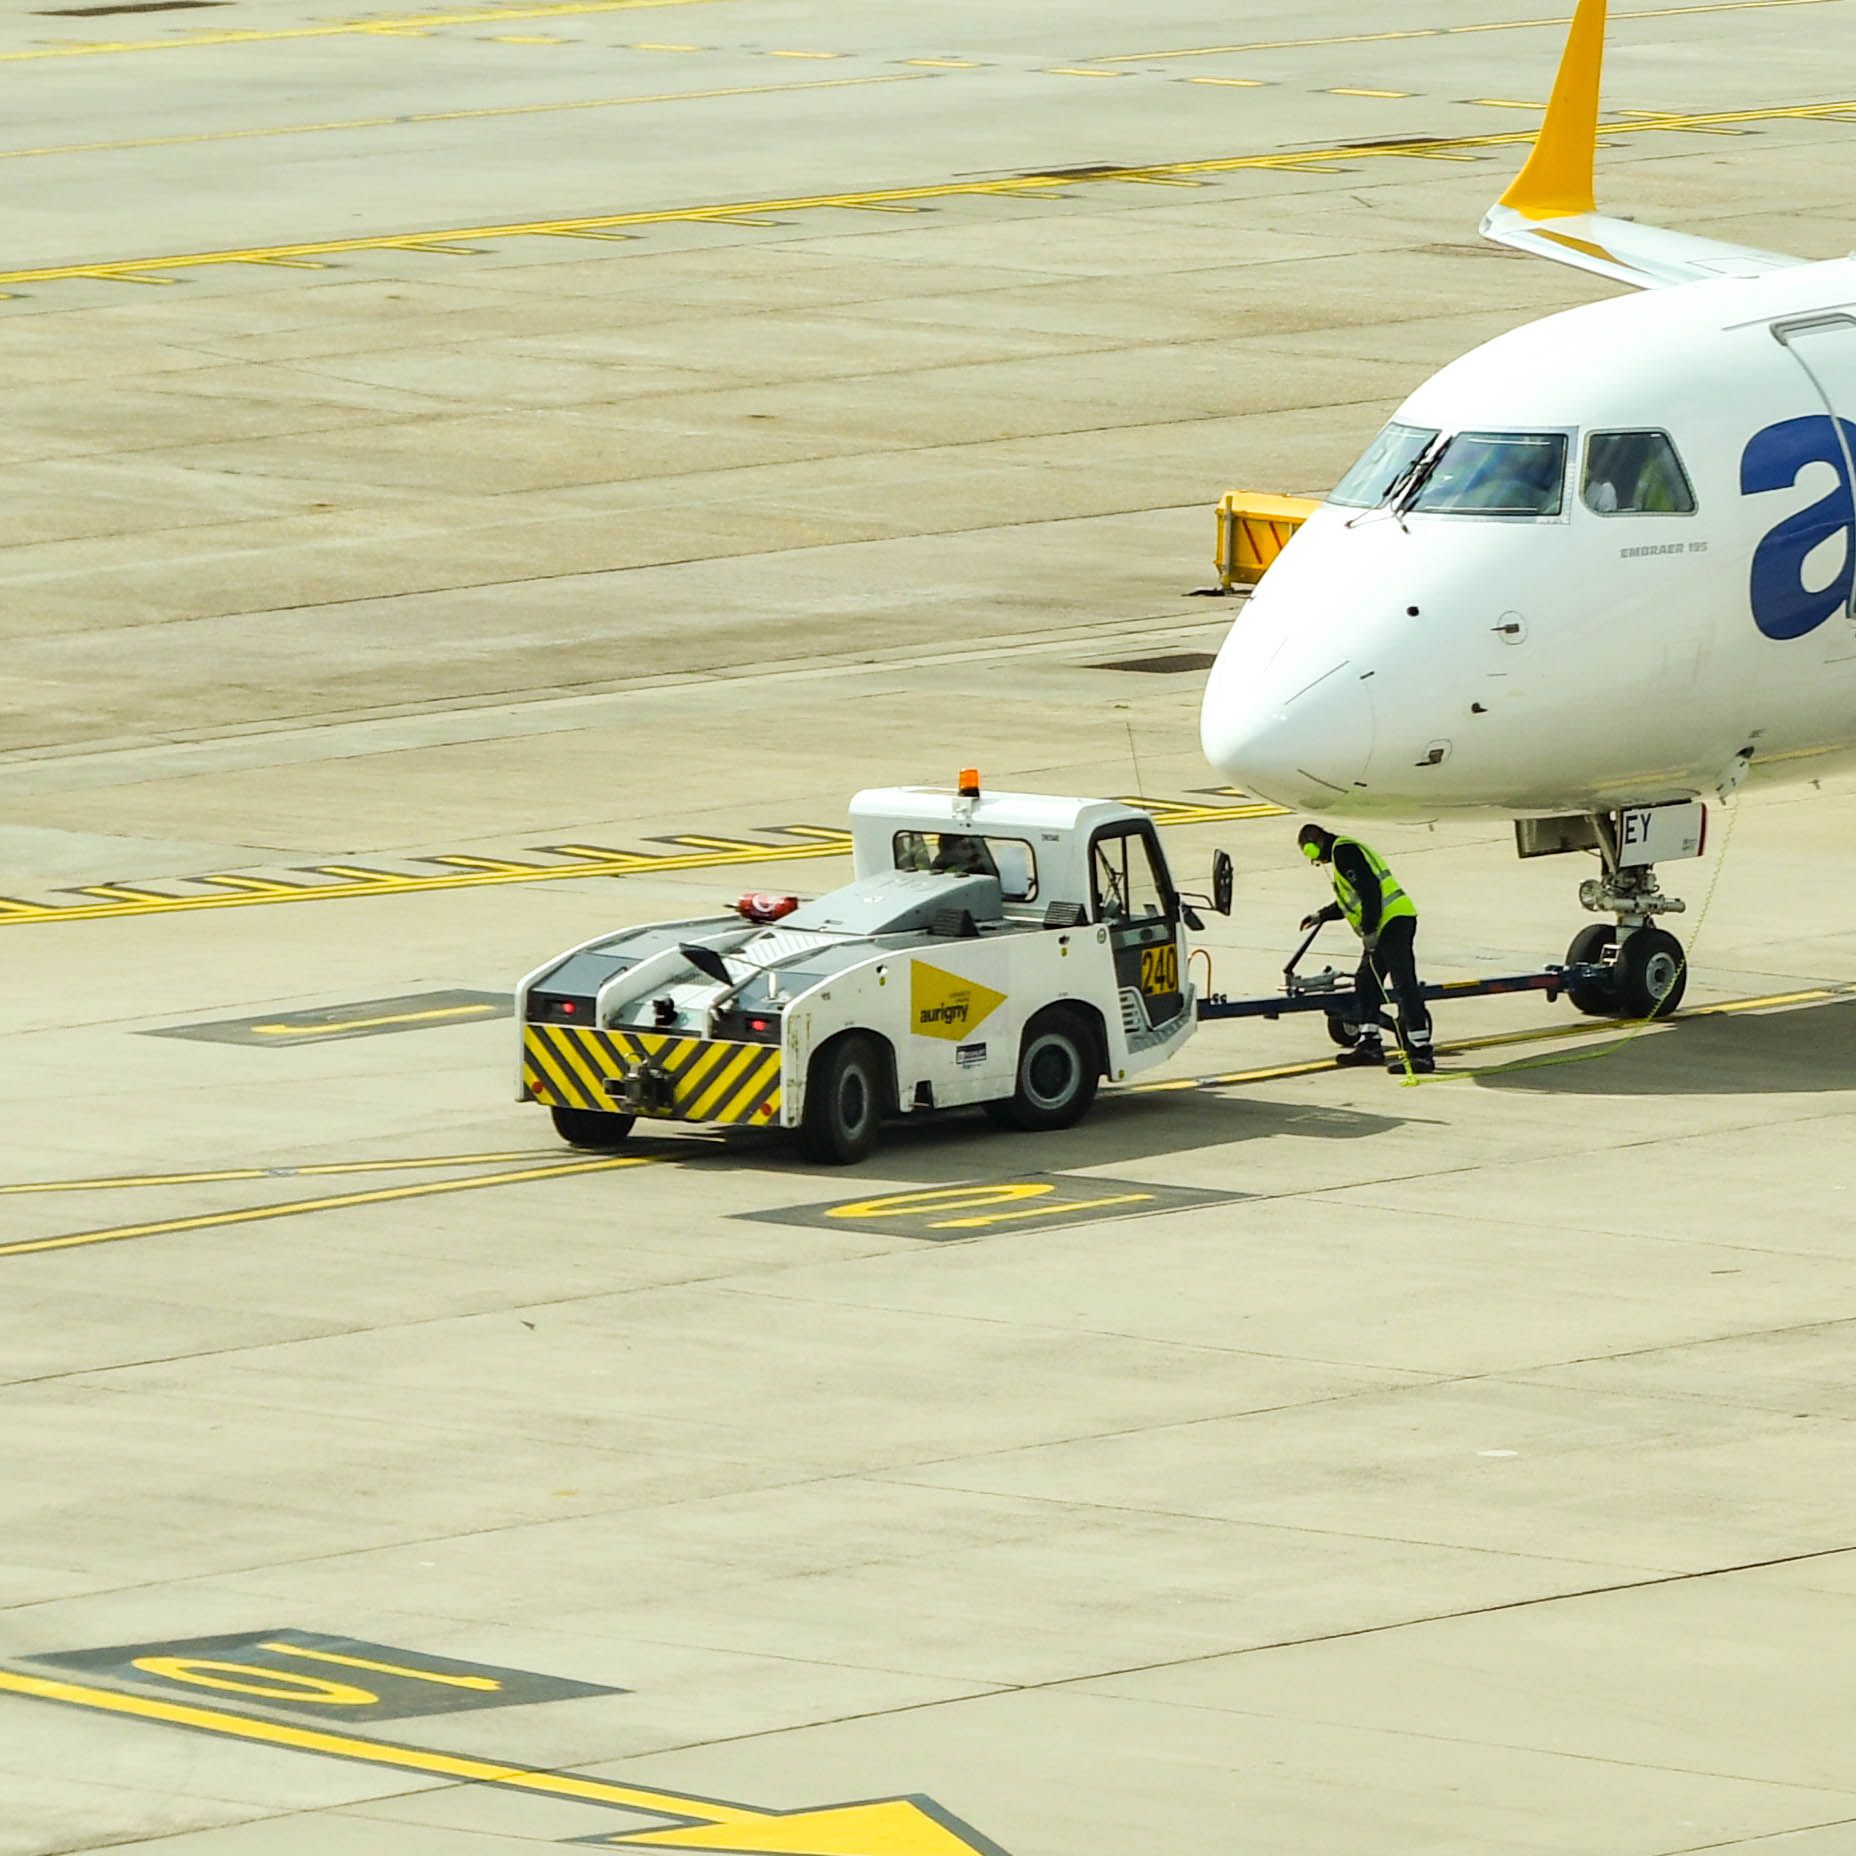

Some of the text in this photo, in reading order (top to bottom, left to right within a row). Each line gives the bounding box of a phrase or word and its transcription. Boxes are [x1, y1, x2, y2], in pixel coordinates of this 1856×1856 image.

[1619, 540, 1708, 559] EMBRAER 195
[1624, 813, 1652, 845] EY
[1142, 947, 1177, 994] 240
[919, 1001, 969, 1025] aurigny
